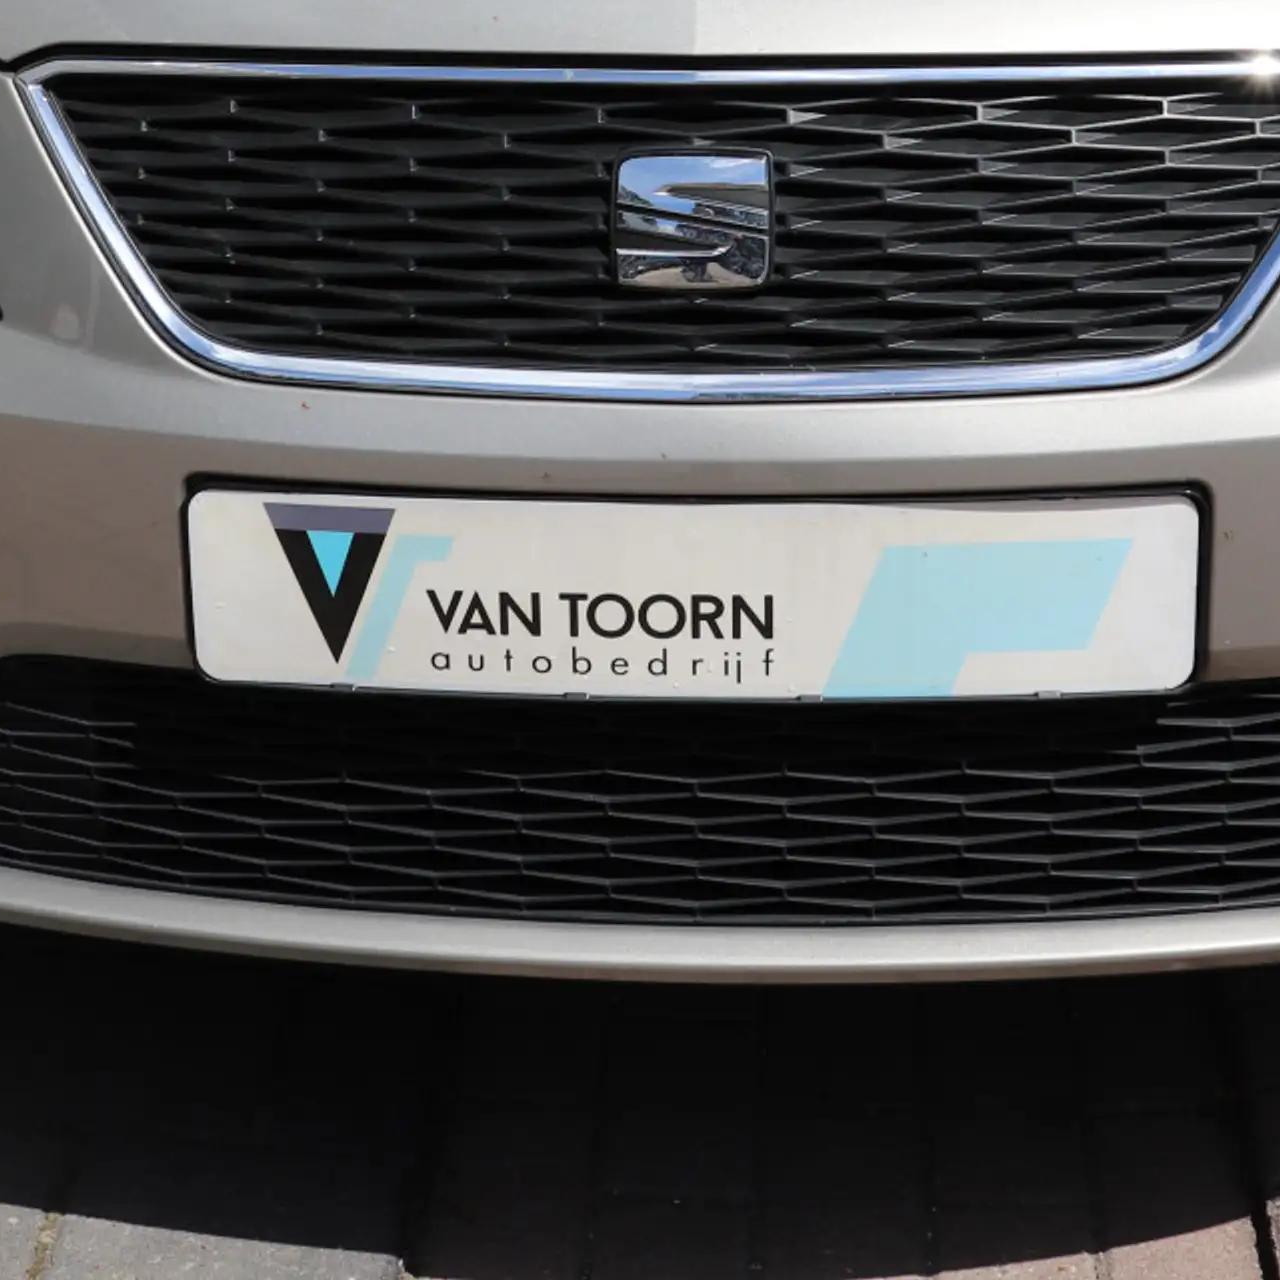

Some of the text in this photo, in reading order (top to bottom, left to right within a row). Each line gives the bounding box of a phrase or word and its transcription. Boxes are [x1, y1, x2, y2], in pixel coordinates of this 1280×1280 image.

[426, 589, 774, 640] VAN TOORN
[430, 646, 775, 684] autobedrijf
